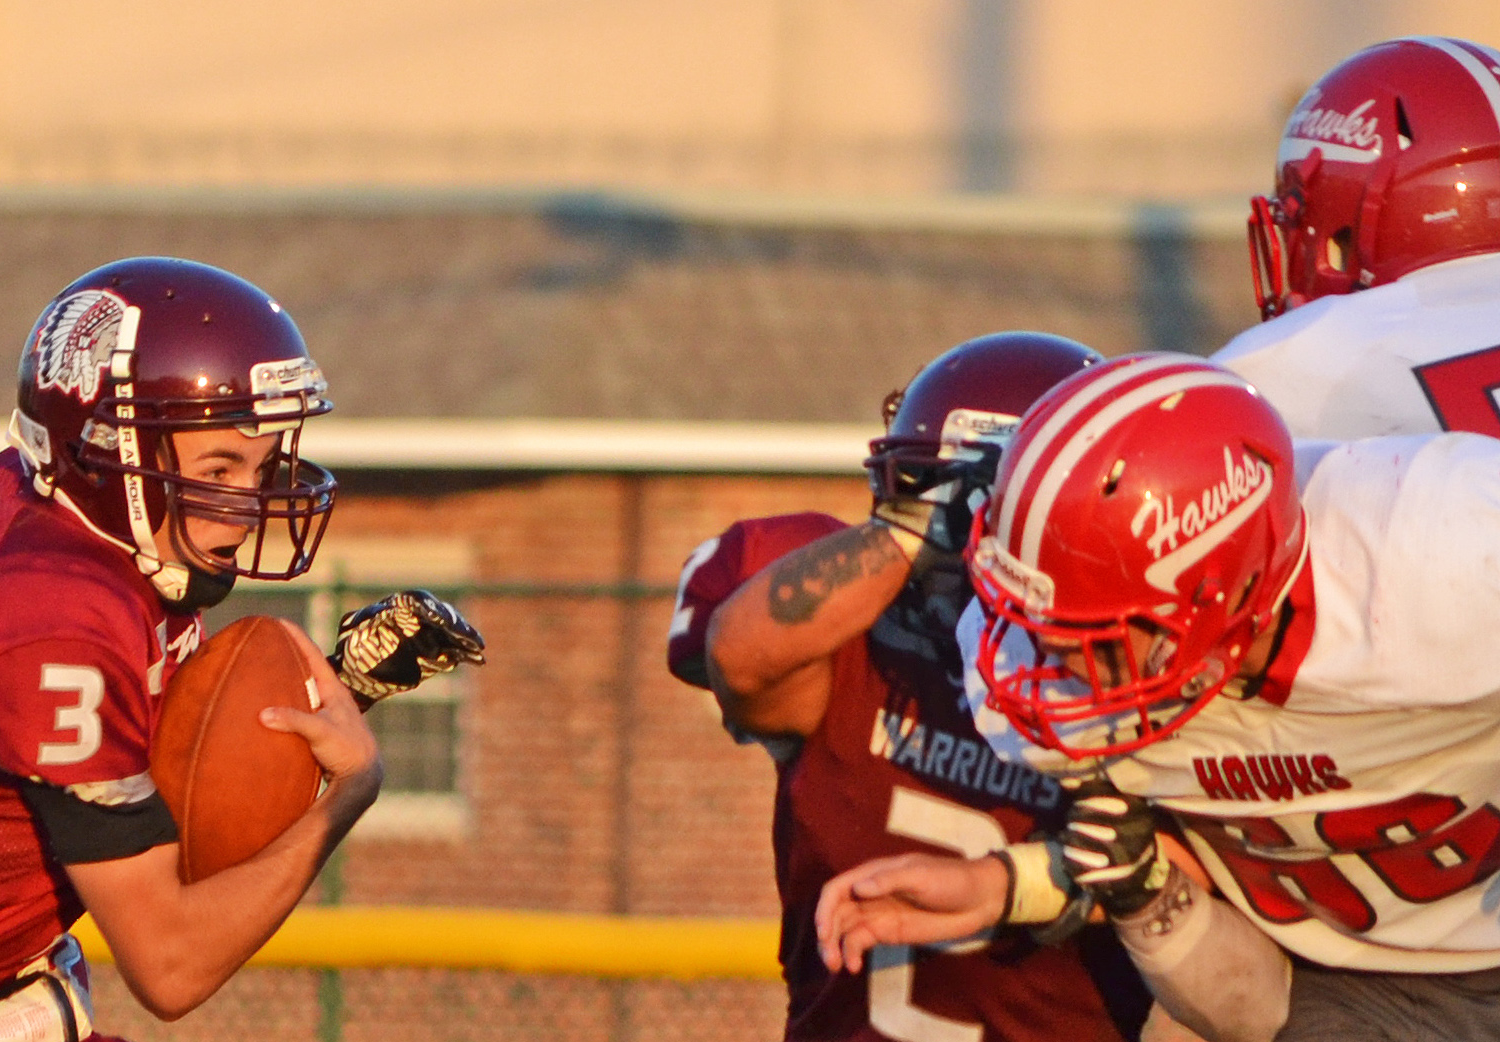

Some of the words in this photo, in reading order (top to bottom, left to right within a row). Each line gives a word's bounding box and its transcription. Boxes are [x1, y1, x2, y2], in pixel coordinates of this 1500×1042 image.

[1131, 445, 1262, 560] Hawks
[37, 663, 106, 766] 3
[869, 708, 1061, 808] WARRIORS
[1192, 753, 1353, 802] HAWKS
